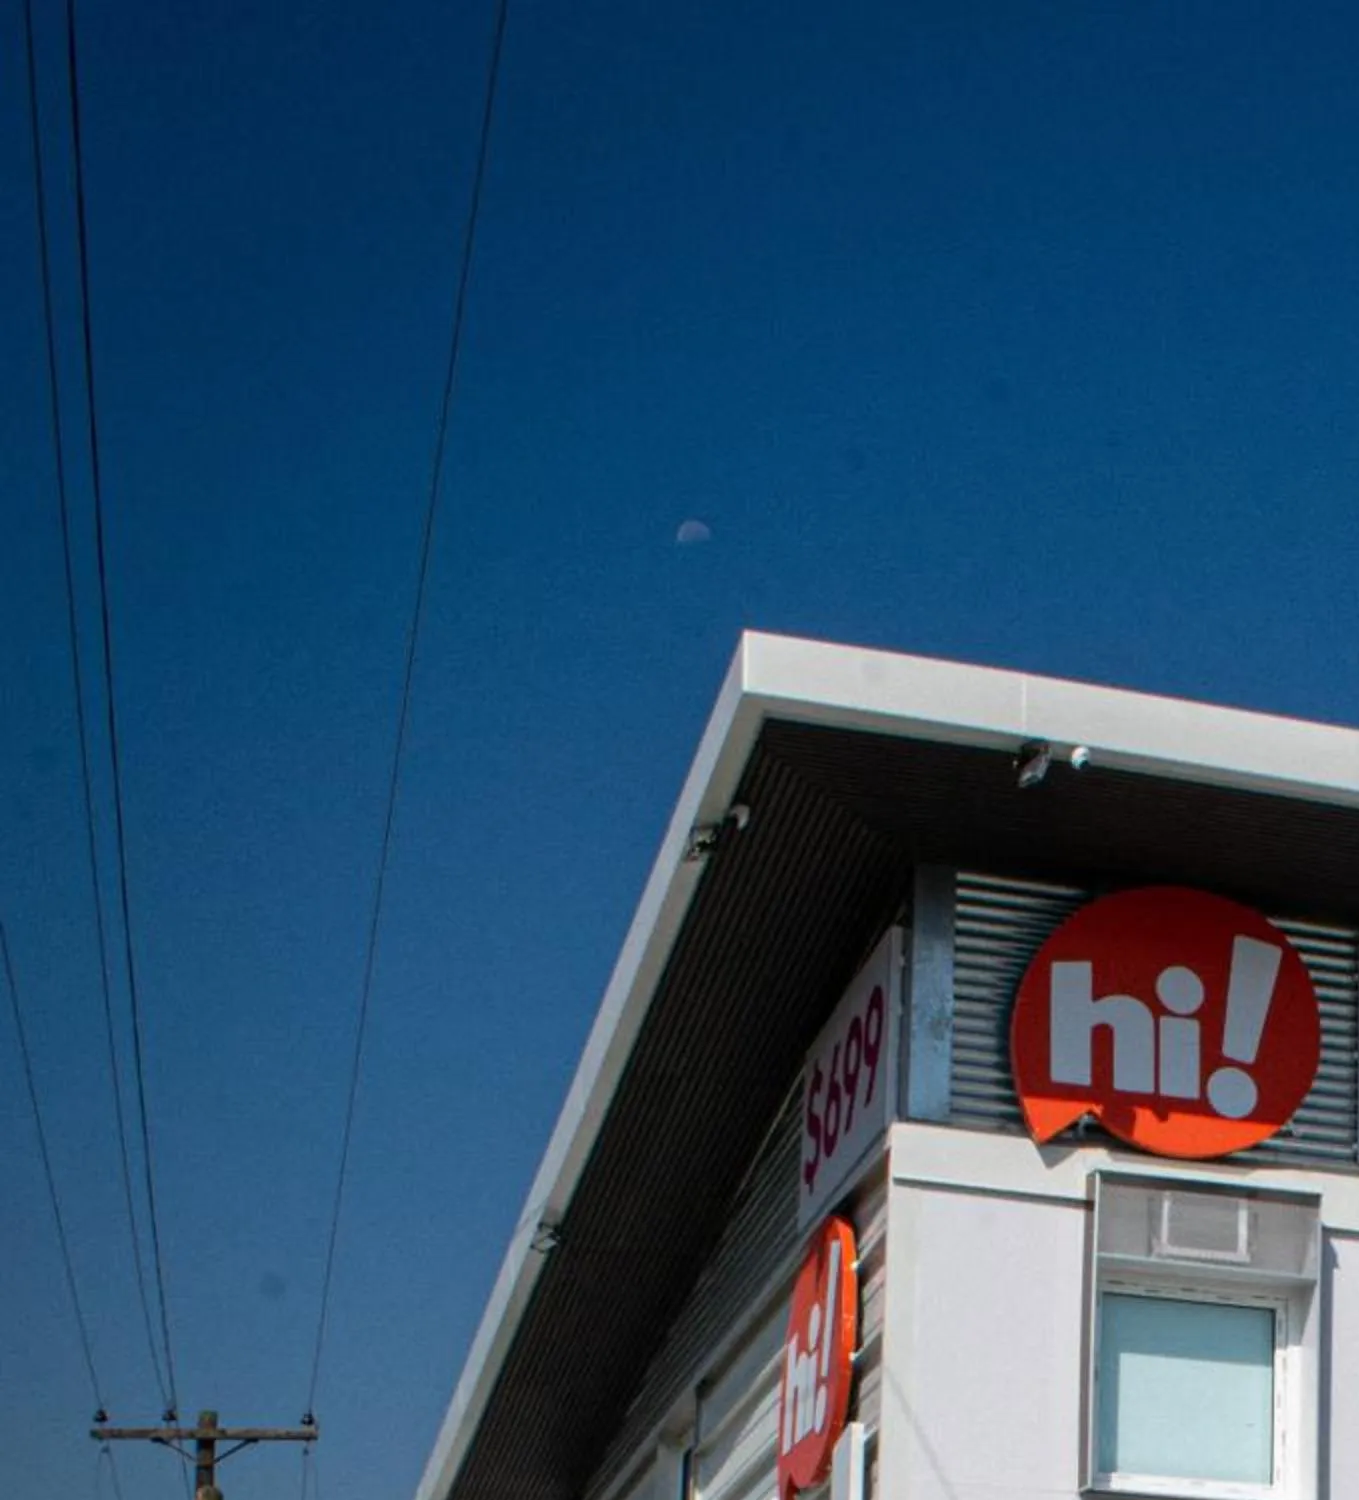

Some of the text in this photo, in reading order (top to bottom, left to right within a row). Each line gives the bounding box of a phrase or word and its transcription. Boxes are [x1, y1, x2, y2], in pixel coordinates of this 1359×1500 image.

[803, 984, 884, 1197] $699
[1049, 934, 1284, 1120] hi!
[781, 1239, 841, 1457] hi!
